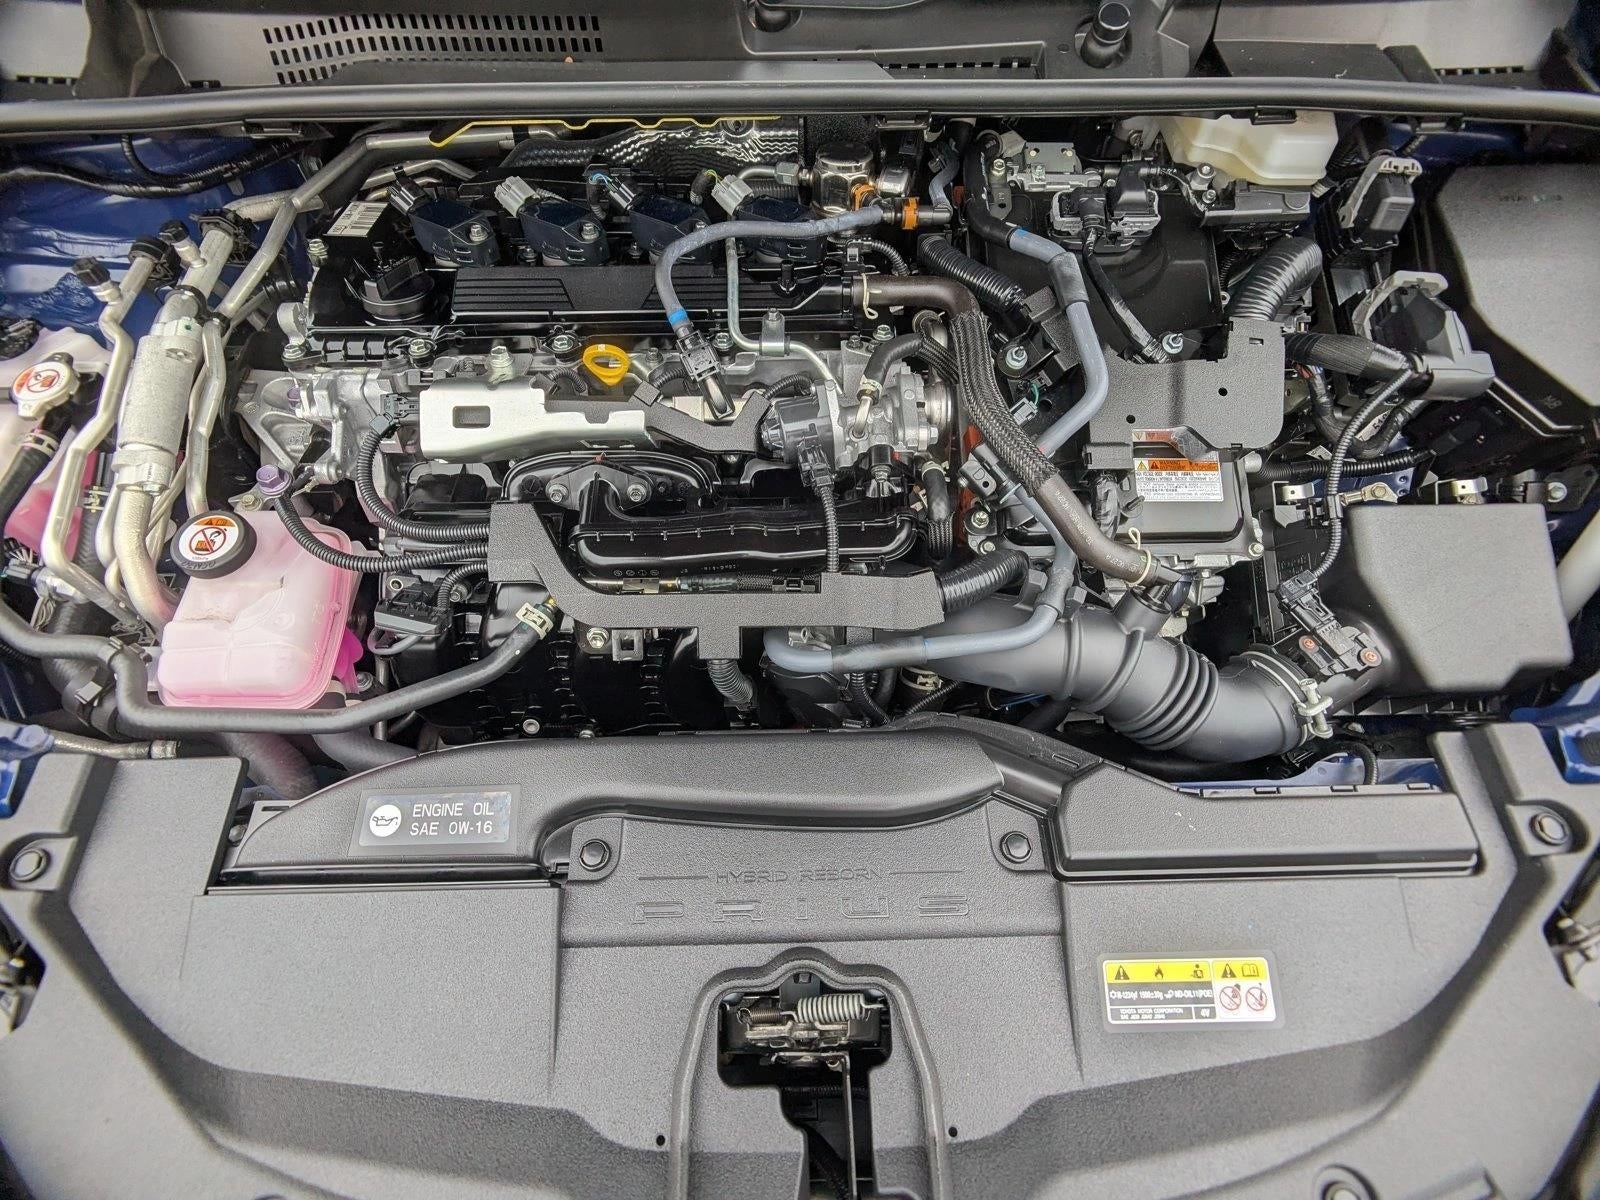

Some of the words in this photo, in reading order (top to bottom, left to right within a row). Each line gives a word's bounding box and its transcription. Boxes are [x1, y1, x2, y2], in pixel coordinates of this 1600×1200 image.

[411, 802, 464, 818] ENGINE
[473, 801, 495, 816] OIL
[409, 821, 440, 835] SAE
[448, 819, 493, 835] 0W-16
[716, 869, 789, 884] HYBRID
[799, 867, 882, 882] REBORN
[634, 894, 970, 924] PRIUS
